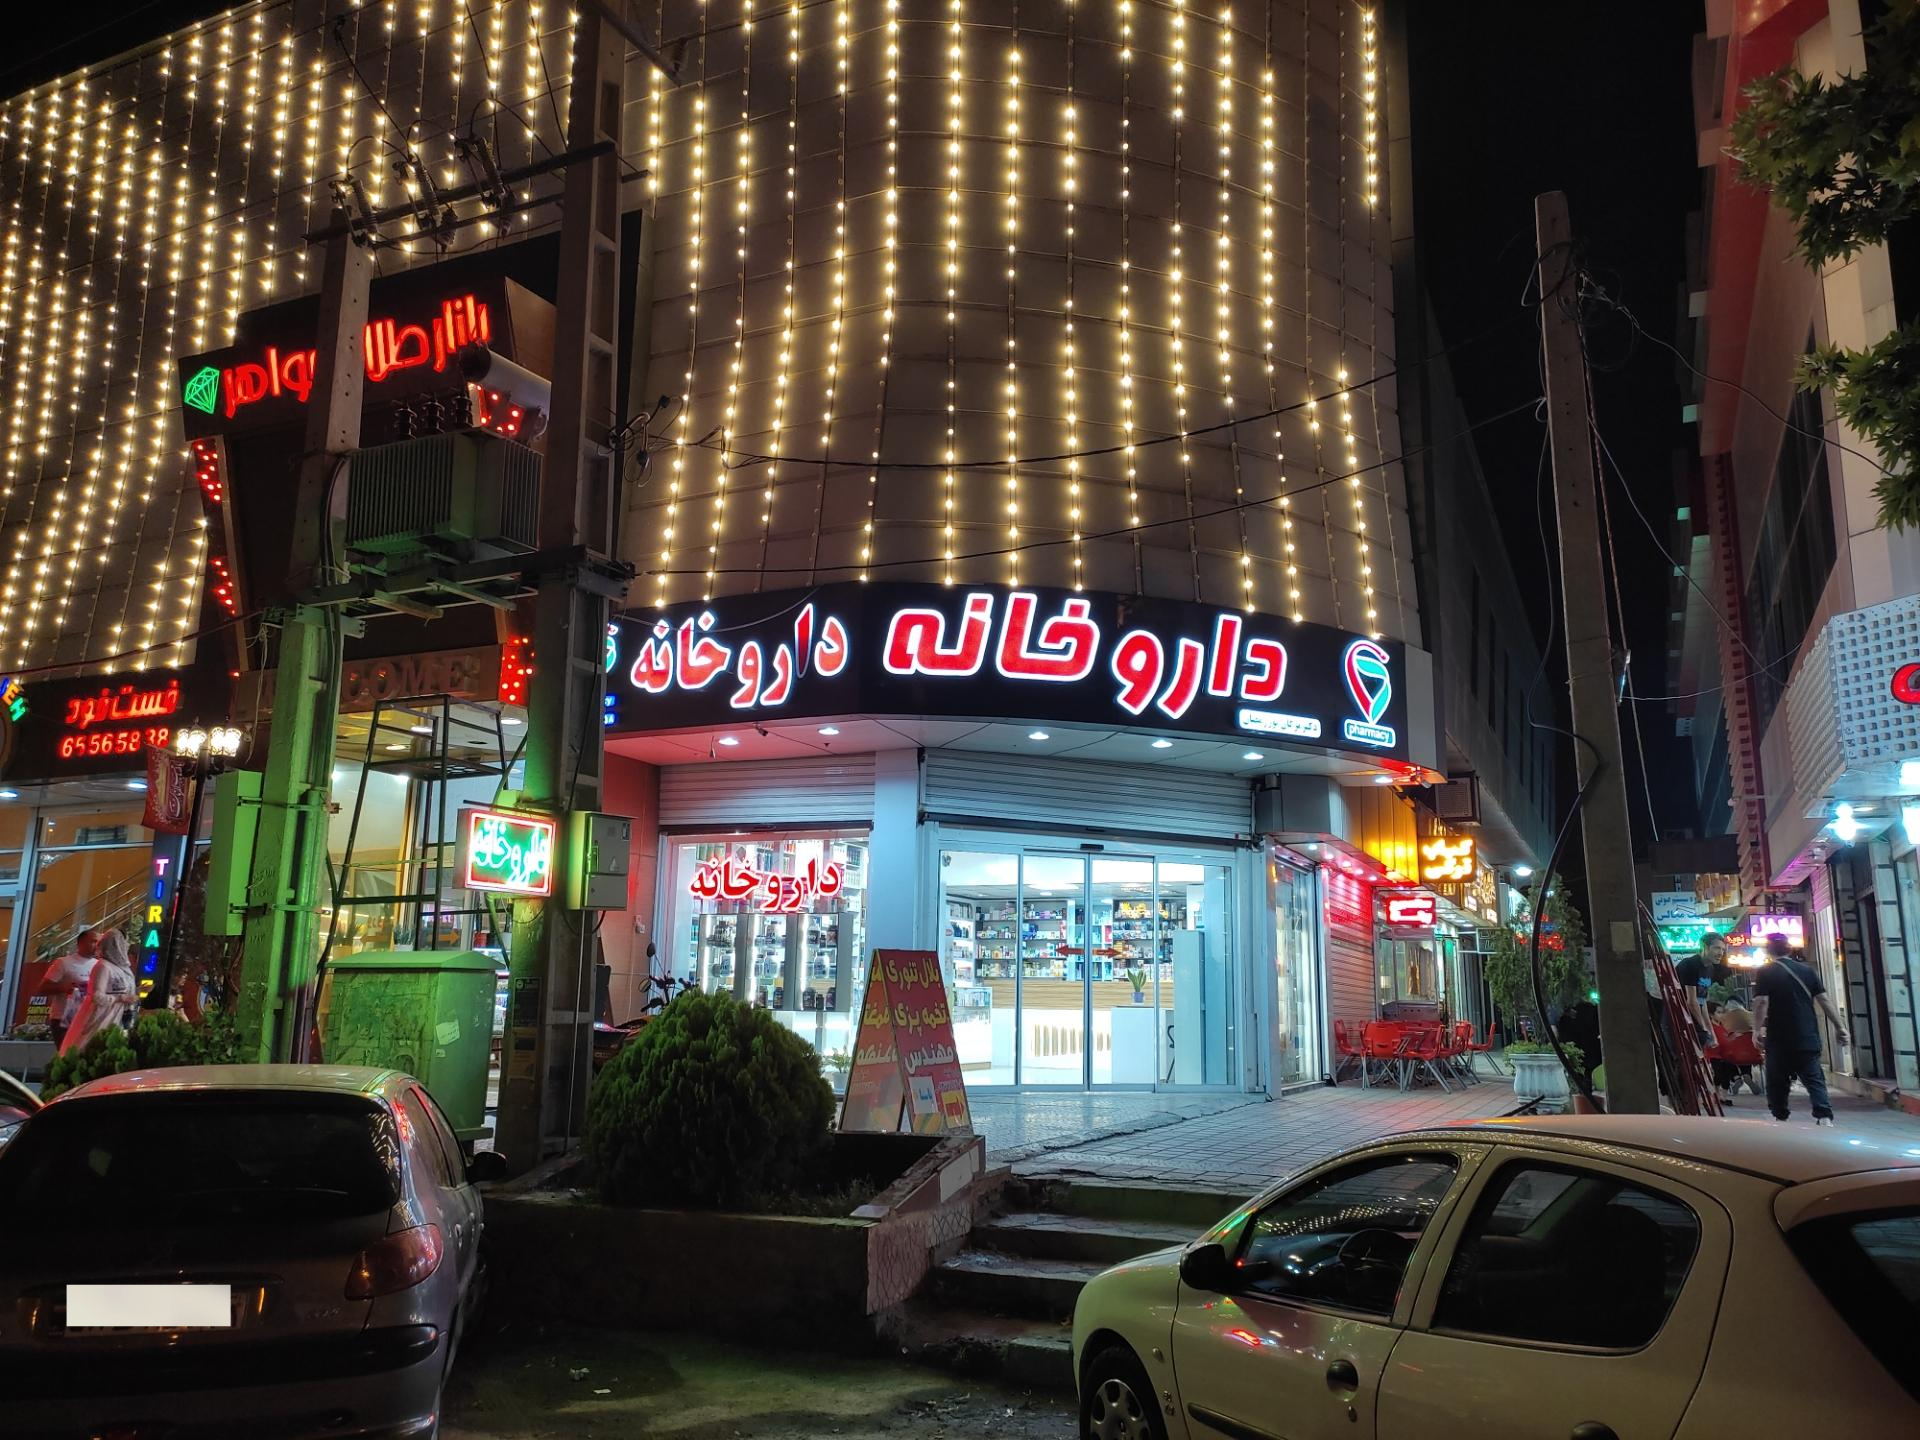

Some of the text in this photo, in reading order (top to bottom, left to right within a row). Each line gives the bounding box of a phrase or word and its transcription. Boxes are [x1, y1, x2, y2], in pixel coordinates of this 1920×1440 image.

[223, 346, 317, 419] واهر
[630, 602, 849, 709] داروخانه
[882, 591, 1288, 720] داروخانه
[64, 679, 180, 729] فست فود
[1348, 723, 1389, 744] pharmacy
[469, 818, 550, 886] داروخانه
[688, 855, 842, 913] داروخانه
[885, 959, 919, 991] تنوری
[922, 1001, 948, 1031] تخمه
[904, 1042, 955, 1075] مهندس
